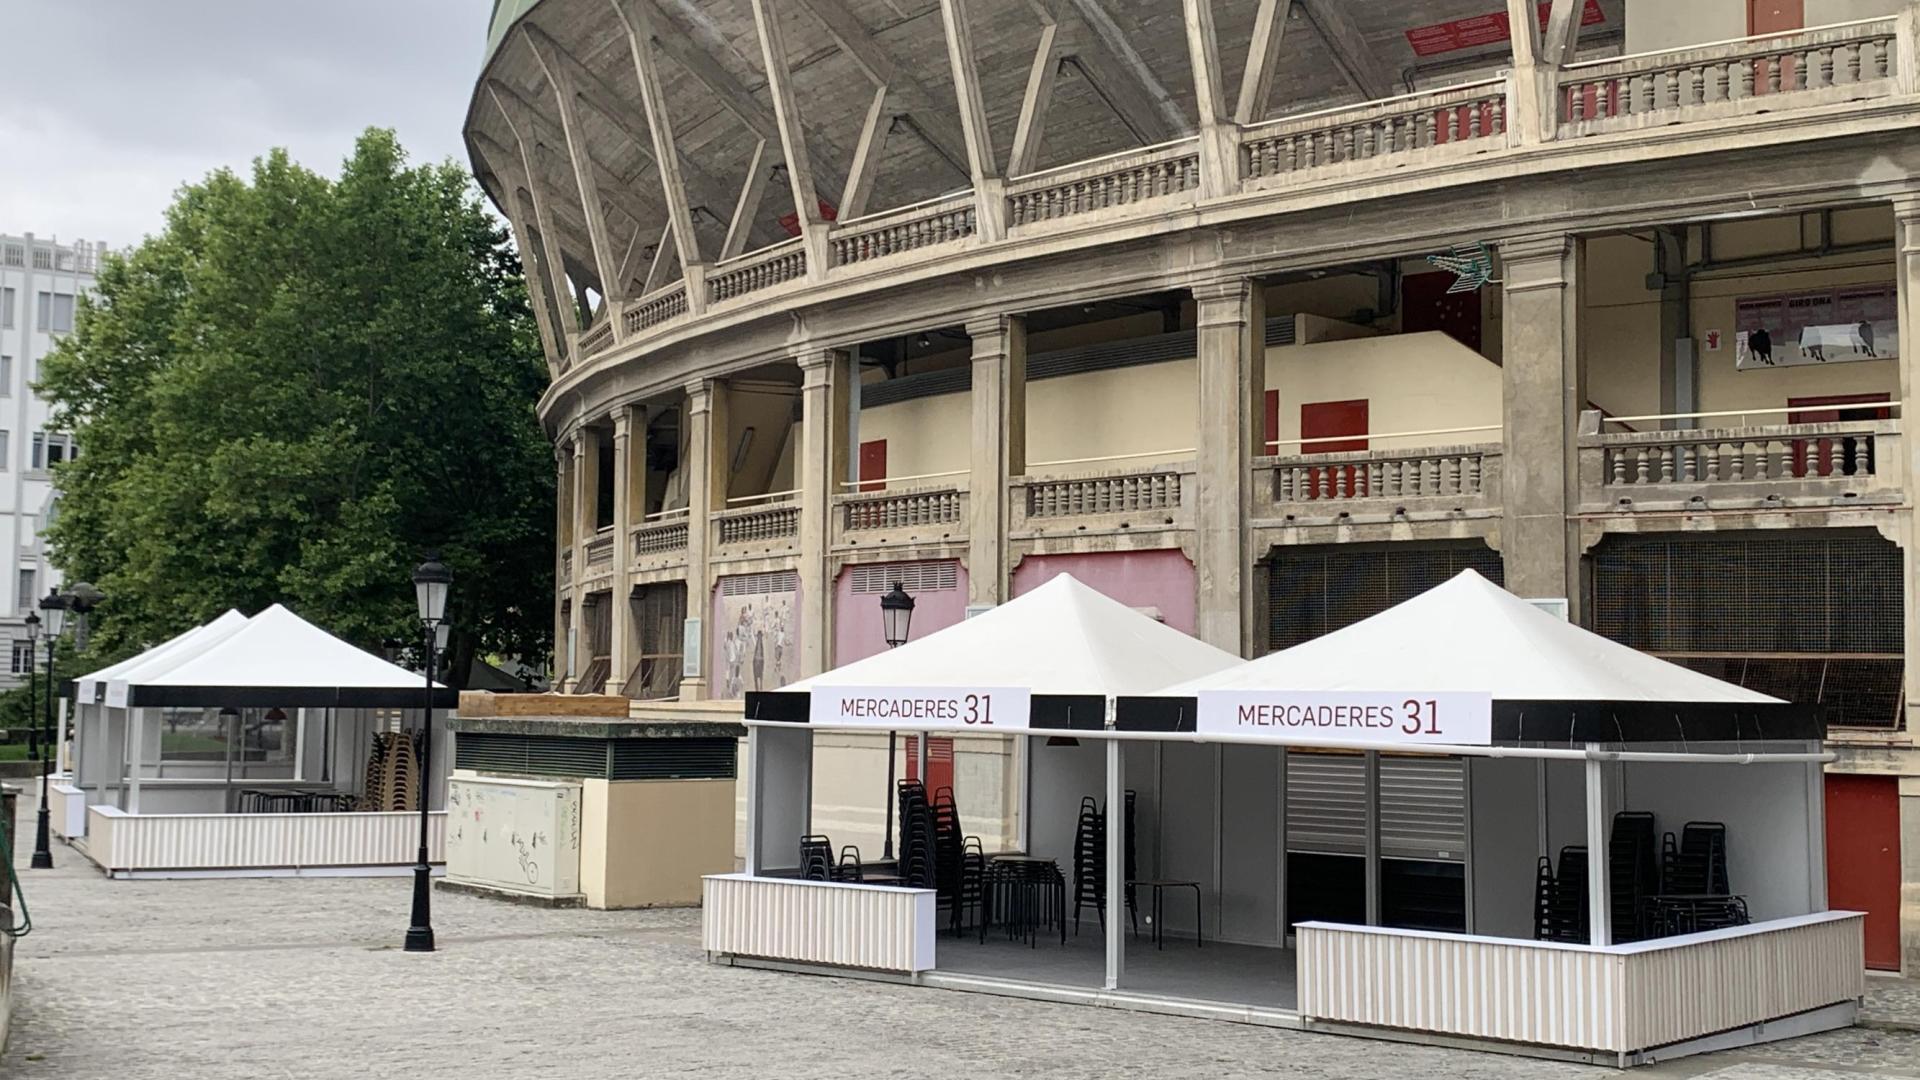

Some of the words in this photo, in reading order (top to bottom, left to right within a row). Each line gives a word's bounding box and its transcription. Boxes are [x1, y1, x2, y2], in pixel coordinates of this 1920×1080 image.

[840, 698, 958, 719] MERCADERES
[963, 694, 994, 725] 31
[1237, 704, 1394, 728] MERCADERES
[1401, 699, 1443, 735] 31
